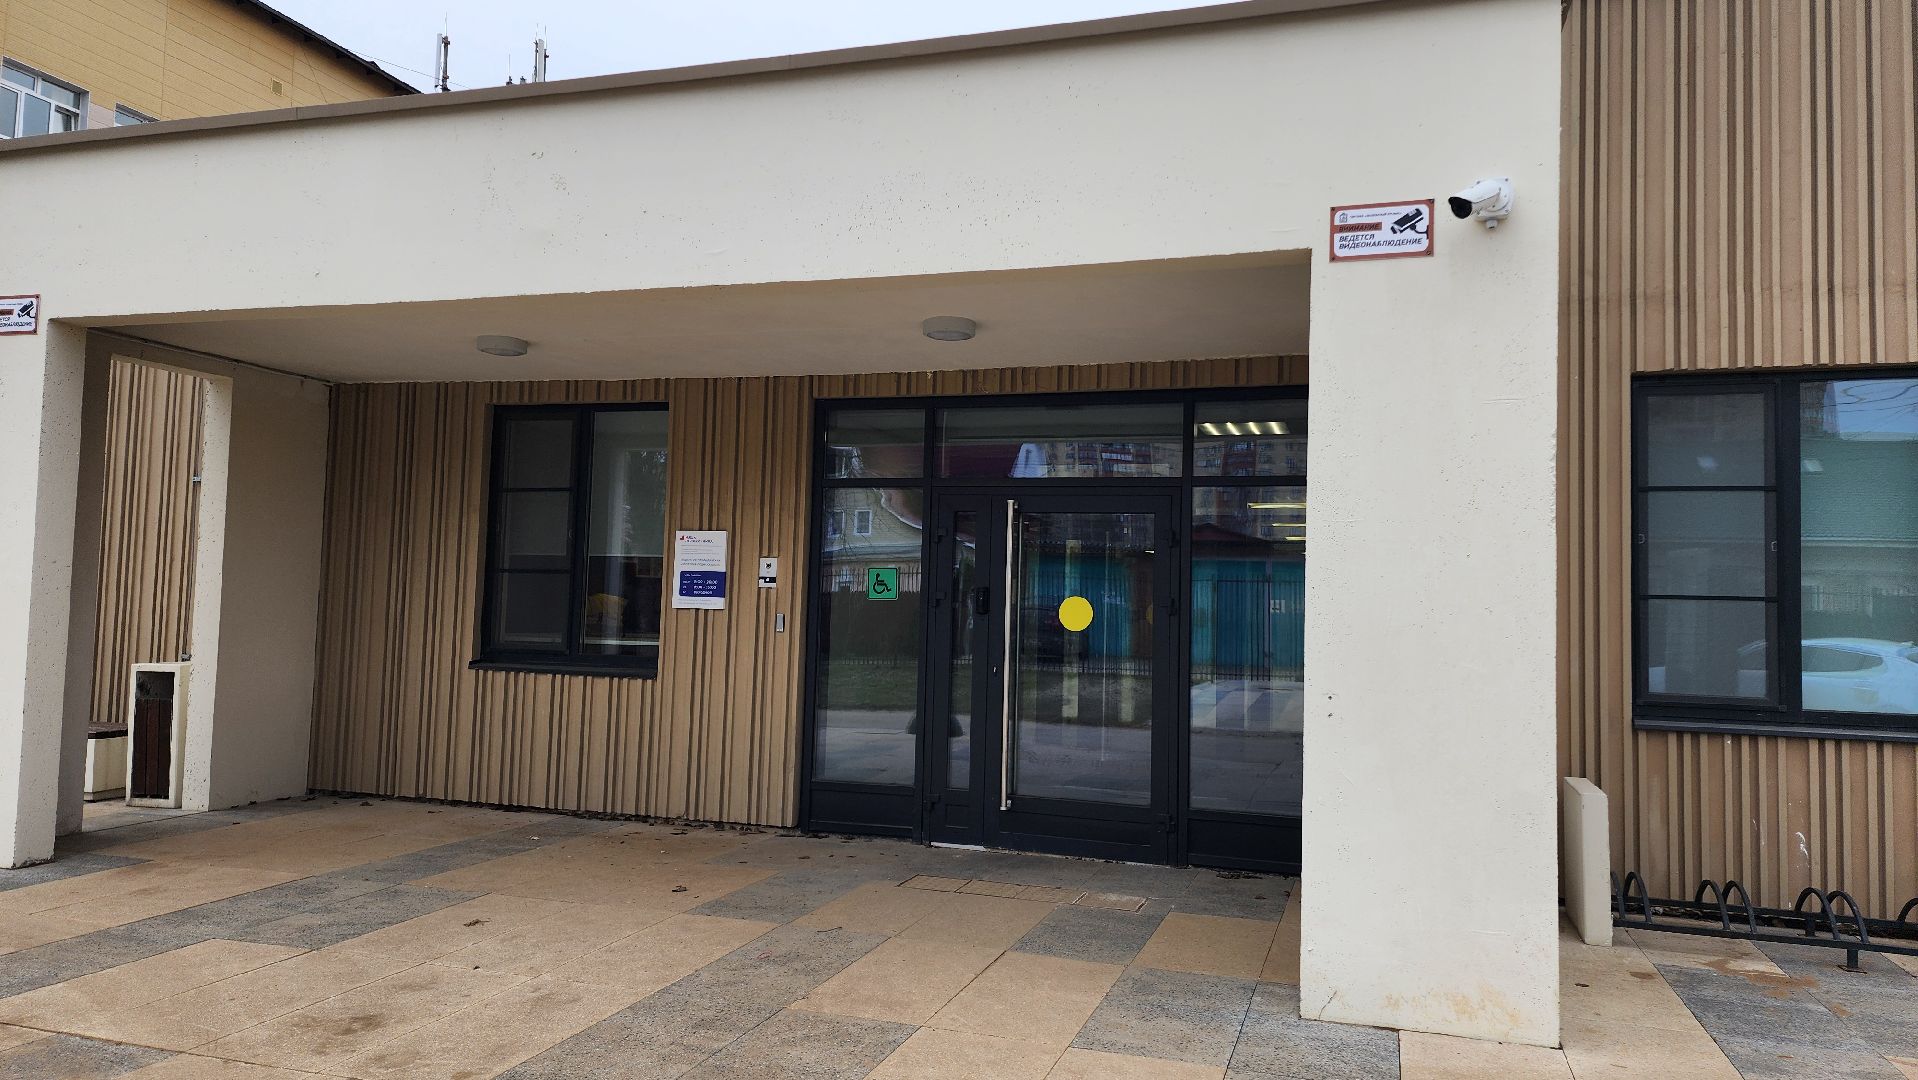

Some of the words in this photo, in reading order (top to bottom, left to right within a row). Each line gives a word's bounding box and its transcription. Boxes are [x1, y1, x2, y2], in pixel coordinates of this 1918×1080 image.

[1339, 223, 1380, 233] ВНИМАНИЕ
[1339, 233, 1375, 243] ВЕДЕТСЯ
[1339, 238, 1423, 250] ВИДЕОНАБЛЮДЕНИЕ
